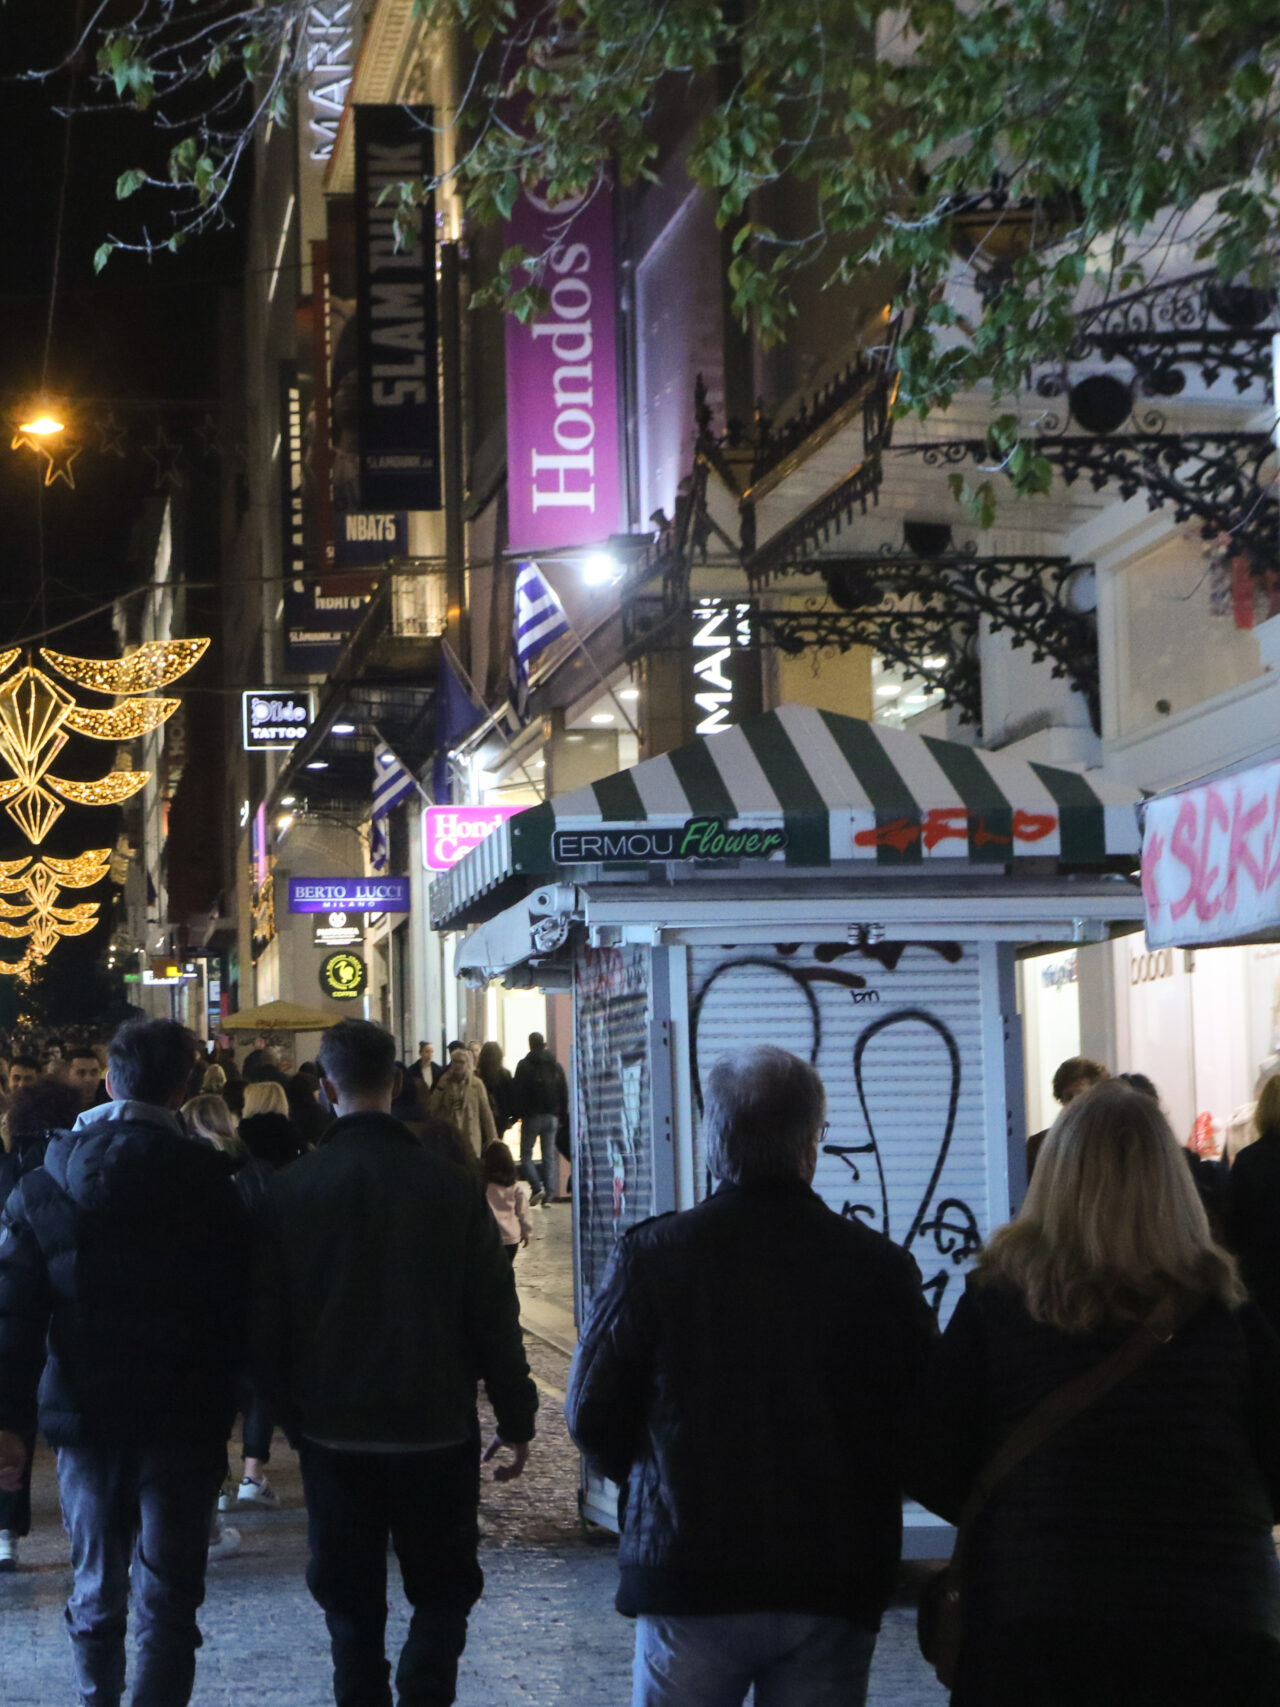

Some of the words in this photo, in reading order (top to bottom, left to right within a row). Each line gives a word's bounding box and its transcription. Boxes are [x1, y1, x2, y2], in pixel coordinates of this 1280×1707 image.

[532, 242, 596, 514] Hondos
[346, 514, 396, 541] NBA75
[251, 727, 308, 739] TATTOO
[434, 814, 503, 838] Hond
[559, 834, 673, 857] ERMOU
[680, 821, 782, 855] Flower
[295, 886, 346, 898] BERTO
[355, 885, 403, 898] LUCCI
